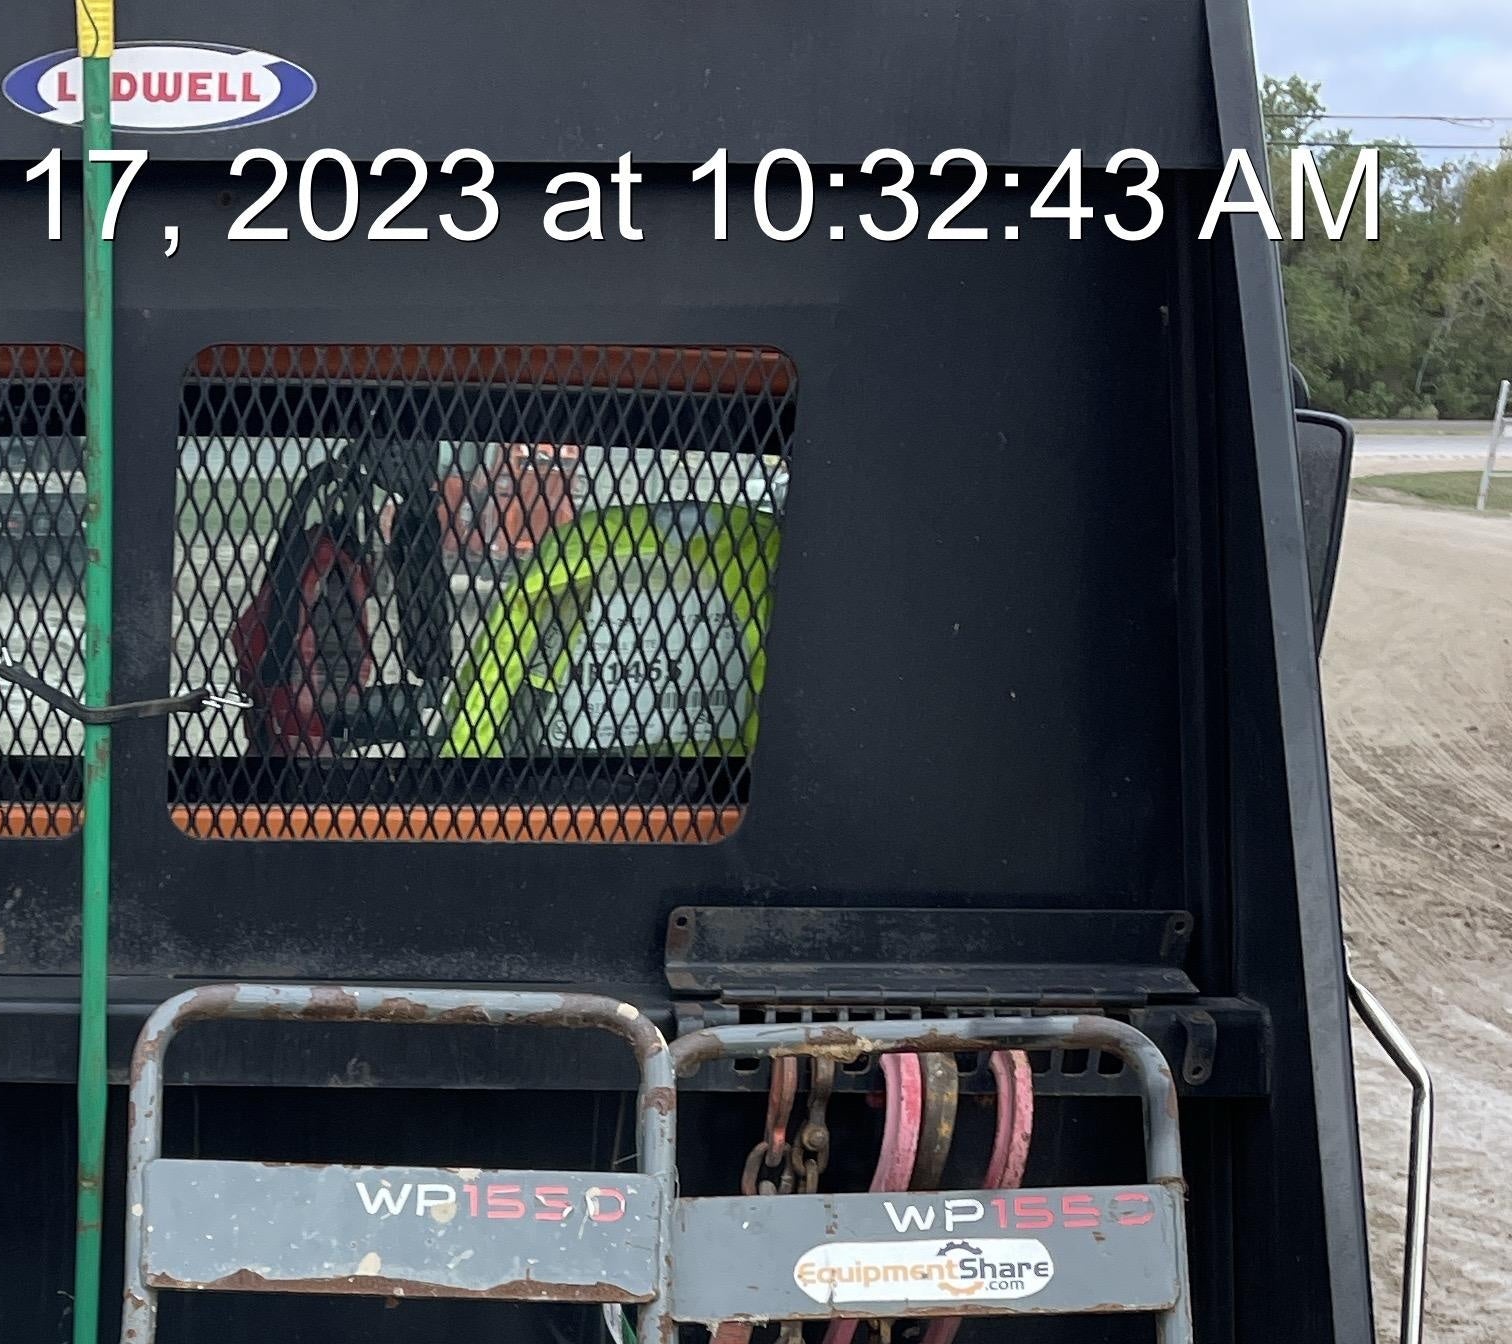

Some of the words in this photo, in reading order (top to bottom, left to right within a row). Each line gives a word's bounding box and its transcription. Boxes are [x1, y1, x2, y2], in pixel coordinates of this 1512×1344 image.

[57, 71, 261, 103] LDWELL
[797, 1258, 1050, 1288] EquipmentShare
[984, 1279, 1026, 1292] .com
